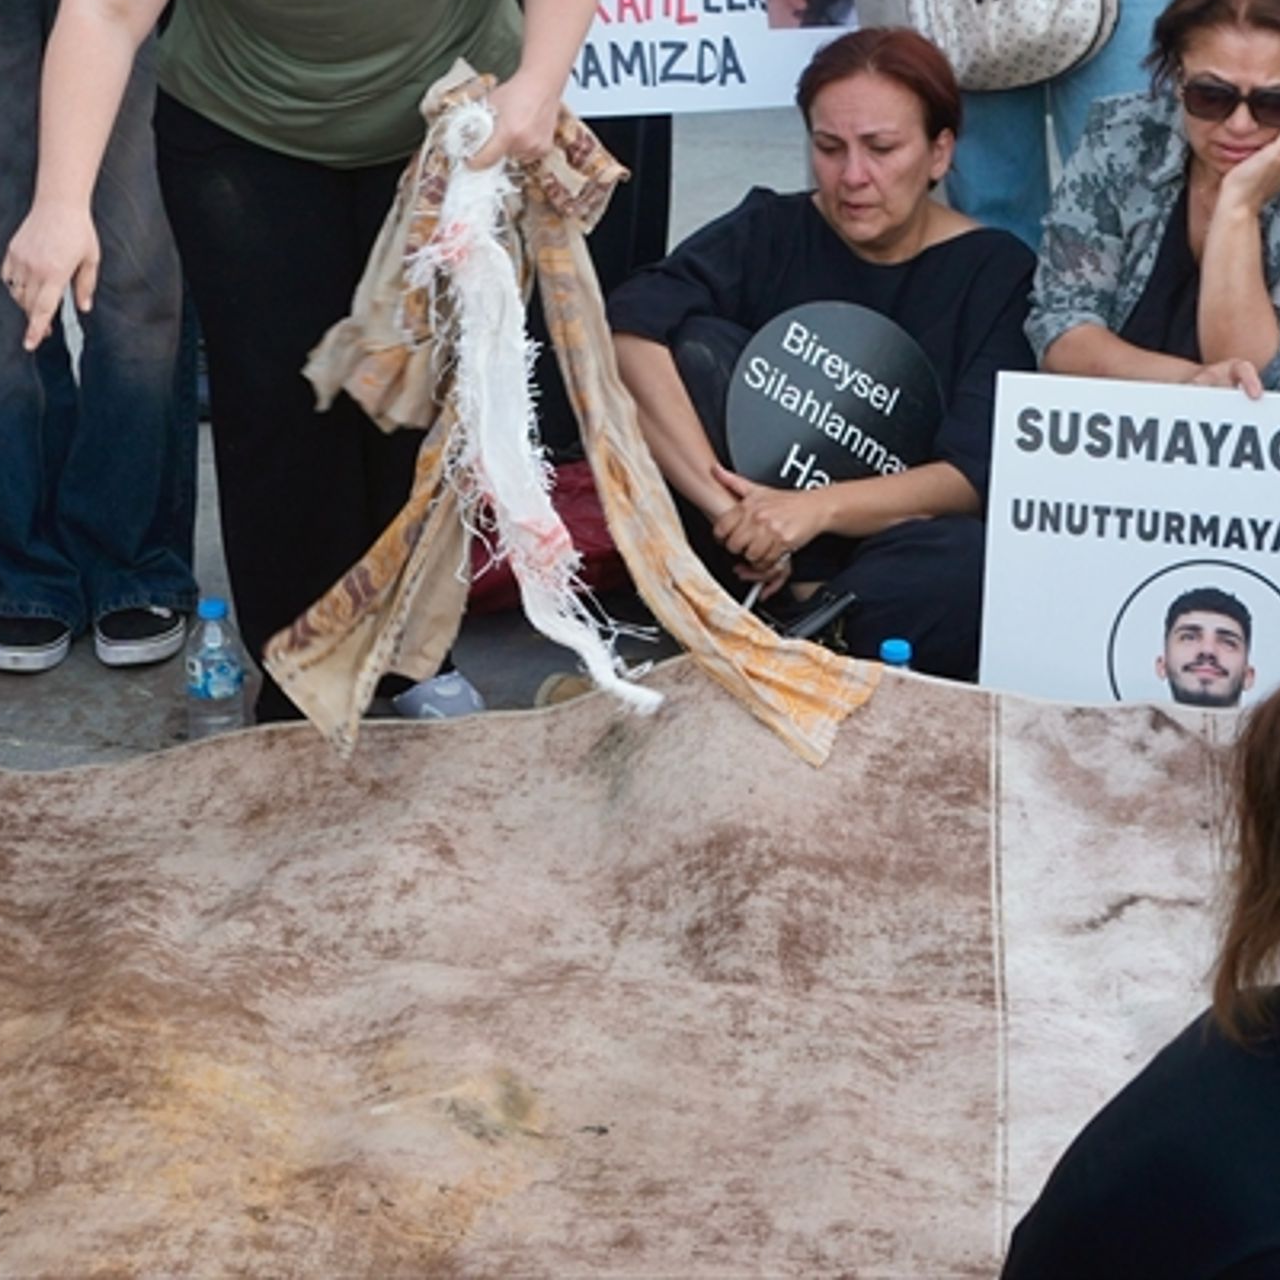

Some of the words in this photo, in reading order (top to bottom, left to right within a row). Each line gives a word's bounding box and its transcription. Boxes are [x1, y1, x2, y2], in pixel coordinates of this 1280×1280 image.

[572, 35, 747, 90] AMIZDA
[782, 322, 900, 416] Bireysel
[744, 357, 908, 478] Silahlanma
